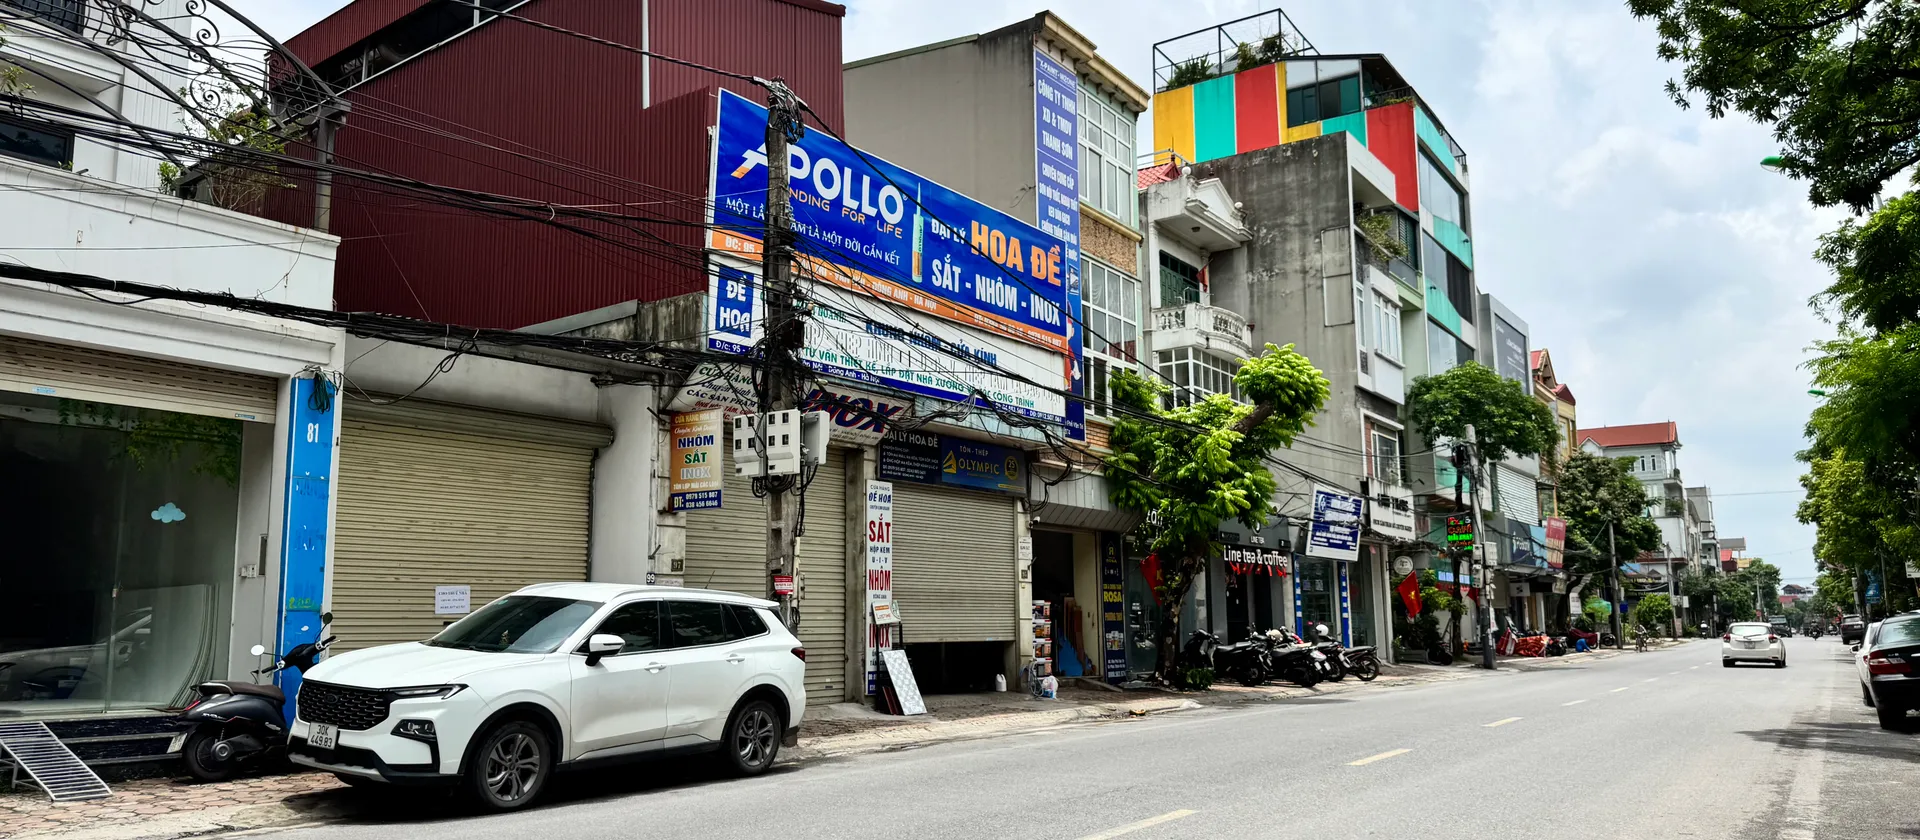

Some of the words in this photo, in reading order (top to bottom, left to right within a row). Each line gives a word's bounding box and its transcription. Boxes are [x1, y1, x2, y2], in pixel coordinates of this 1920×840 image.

[725, 197, 749, 216] MỘT
[752, 202, 766, 220] LẦ
[841, 207, 866, 226] FOR
[876, 220, 903, 239] LIFE
[743, 243, 755, 254] 95
[808, 224, 820, 240] LÀ
[822, 231, 843, 248] MỘT
[844, 238, 861, 253] ĐỜI
[862, 243, 883, 258] GẮN
[884, 250, 901, 266] KẾT
[953, 226, 967, 244] LÝ
[970, 220, 1024, 273] HOA
[1030, 244, 1062, 287] ĐỀ
[725, 274, 747, 302] ĐỀ
[931, 254, 962, 293] SẮT
[975, 274, 1018, 312] NHÔM
[1030, 294, 1061, 327] INOX
[719, 306, 751, 333] HOA
[732, 342, 741, 352] 95
[845, 369, 857, 378] Anh
[686, 388, 707, 399] CÁC
[916, 372, 933, 386] NHÀ
[992, 390, 1014, 404] CÔNG
[1015, 395, 1035, 408] TRÌNH
[306, 422, 319, 443] 81
[677, 432, 714, 449] NHÔM
[898, 429, 909, 442] LÝ
[909, 432, 927, 446] HOA
[928, 433, 939, 448] ĐỀ
[960, 445, 971, 453] TÔN
[975, 447, 989, 456] THÉP
[680, 466, 712, 480] INOX
[958, 458, 1000, 475] OLYMPIC
[674, 496, 684, 508] ĐT:
[878, 493, 892, 504] HOA
[868, 513, 891, 544] SẮT
[1223, 545, 1242, 562] Line
[1243, 549, 1256, 564] tea
[1256, 549, 1263, 565] &
[1263, 549, 1288, 568] coffee
[673, 562, 682, 570] 97
[646, 573, 655, 583] 99
[868, 565, 891, 591] NHÔM
[1103, 590, 1123, 603] ROSA
[316, 725, 329, 735] 30K
[310, 735, 333, 748] 449.83
